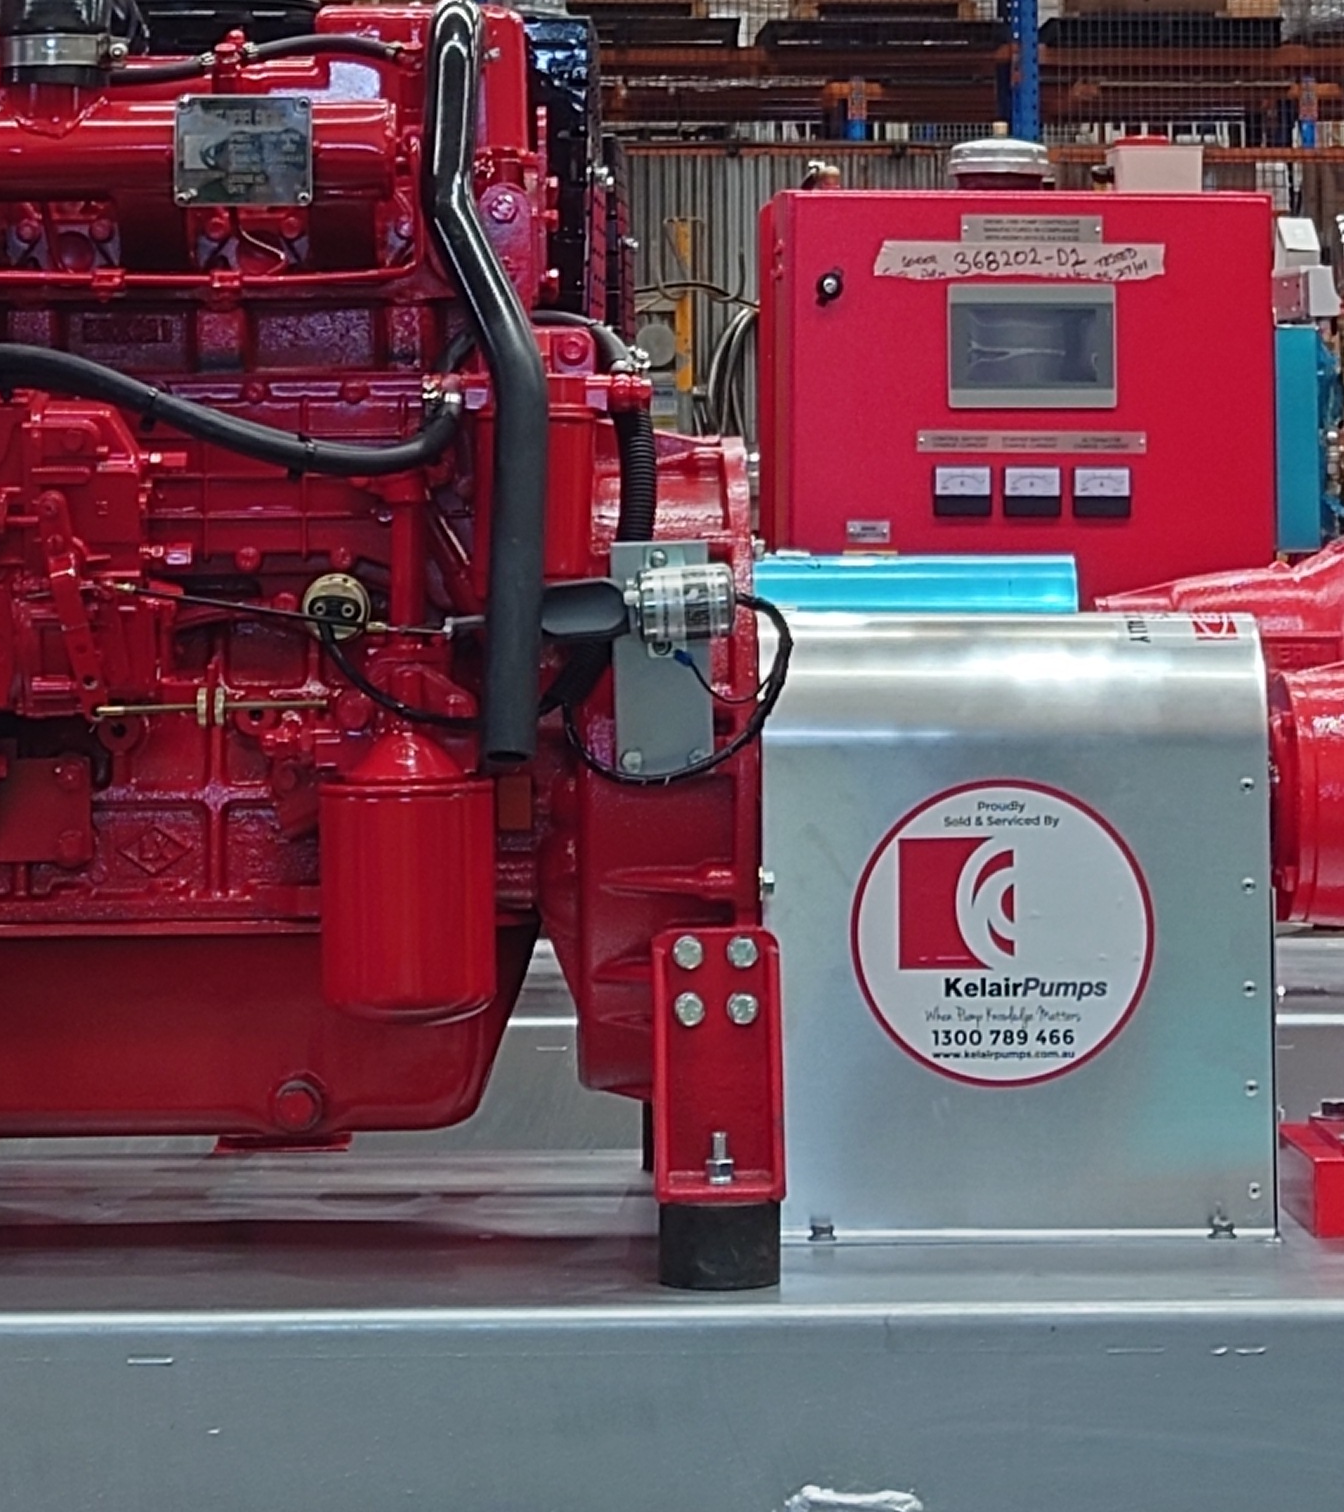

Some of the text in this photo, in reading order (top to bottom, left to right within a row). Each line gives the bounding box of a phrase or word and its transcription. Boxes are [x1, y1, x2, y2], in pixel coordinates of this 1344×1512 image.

[977, 801, 1026, 814] Proudly
[944, 815, 1060, 828] Sold & Serviced By
[944, 977, 1108, 1001] KelairPumps
[924, 1006, 953, 1023] When
[931, 1029, 1075, 1046] 1300 789 466
[931, 1049, 1076, 1061] www.kelairpumps.com.au
